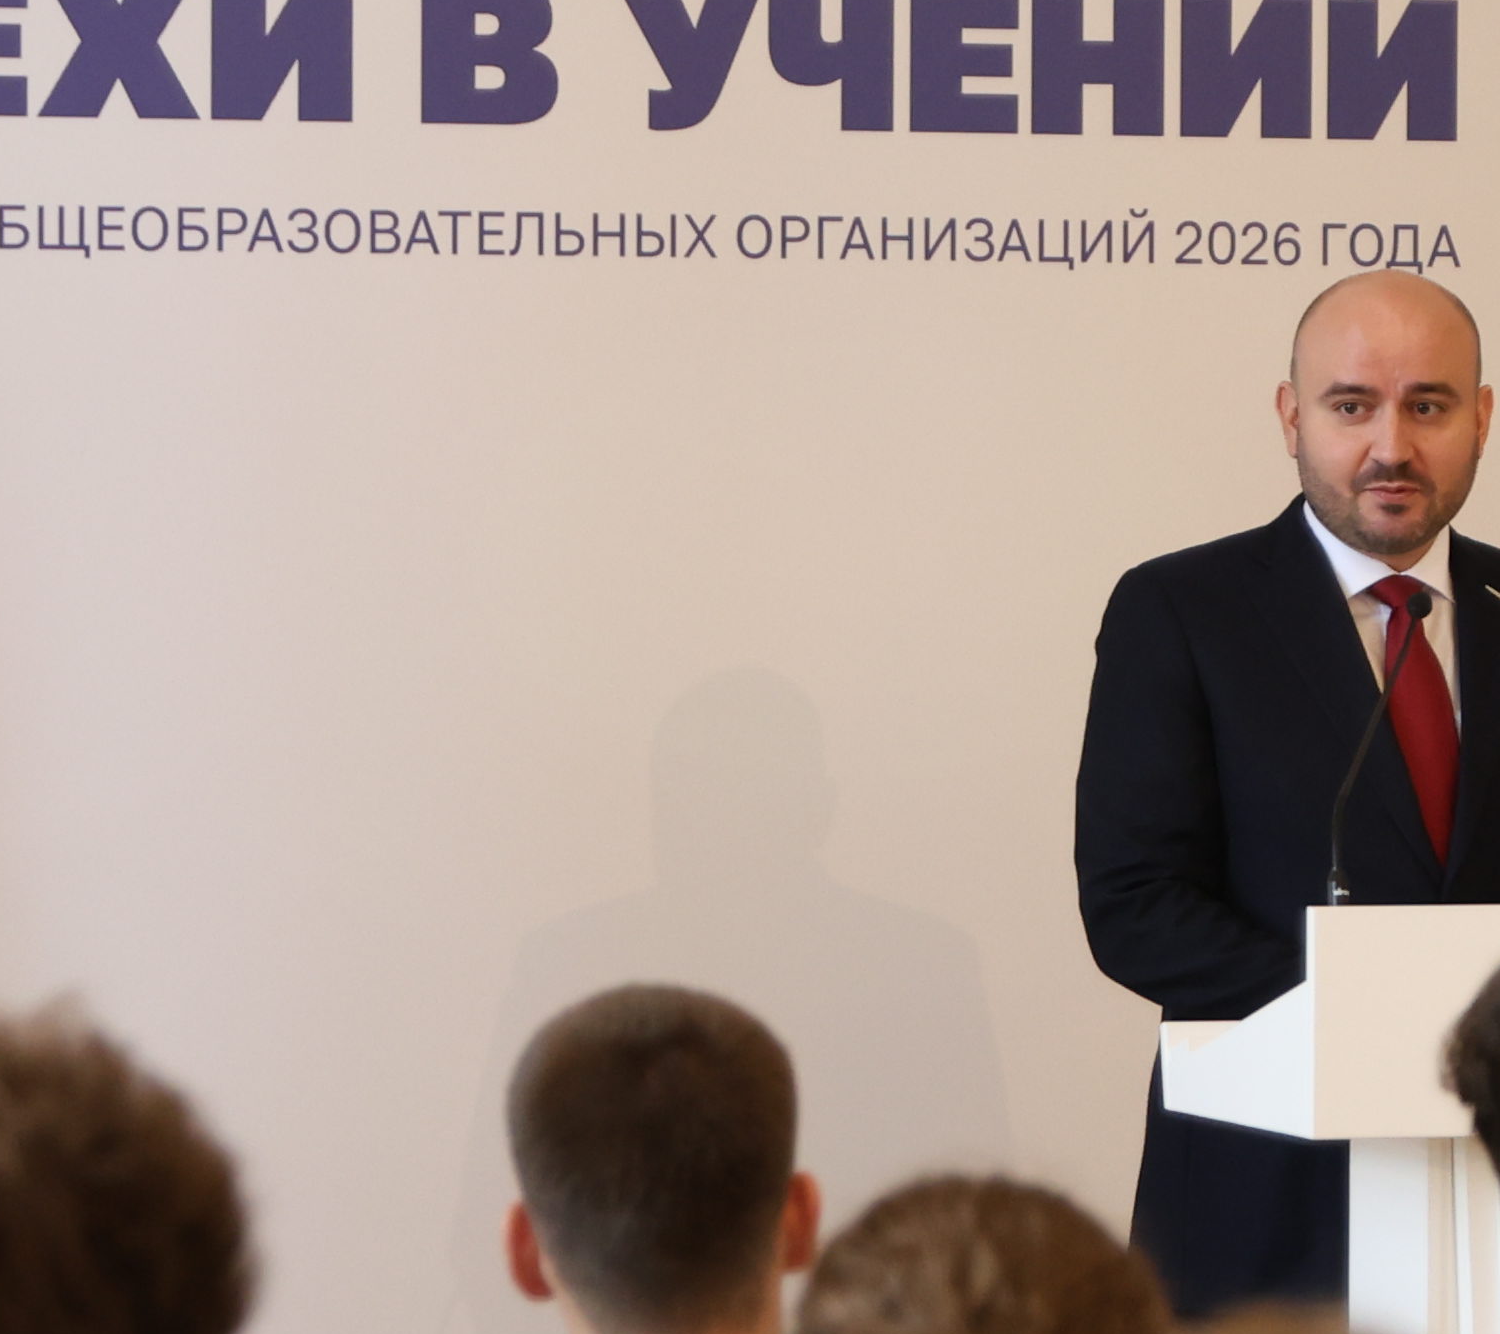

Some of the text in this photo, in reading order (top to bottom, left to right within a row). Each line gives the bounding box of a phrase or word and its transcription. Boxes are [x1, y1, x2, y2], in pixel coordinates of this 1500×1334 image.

[736, 208, 1155, 270] ОРГАНИЗАЦИЙ
[1175, 220, 1301, 266] 2026
[1322, 223, 1461, 274] ГОДА
